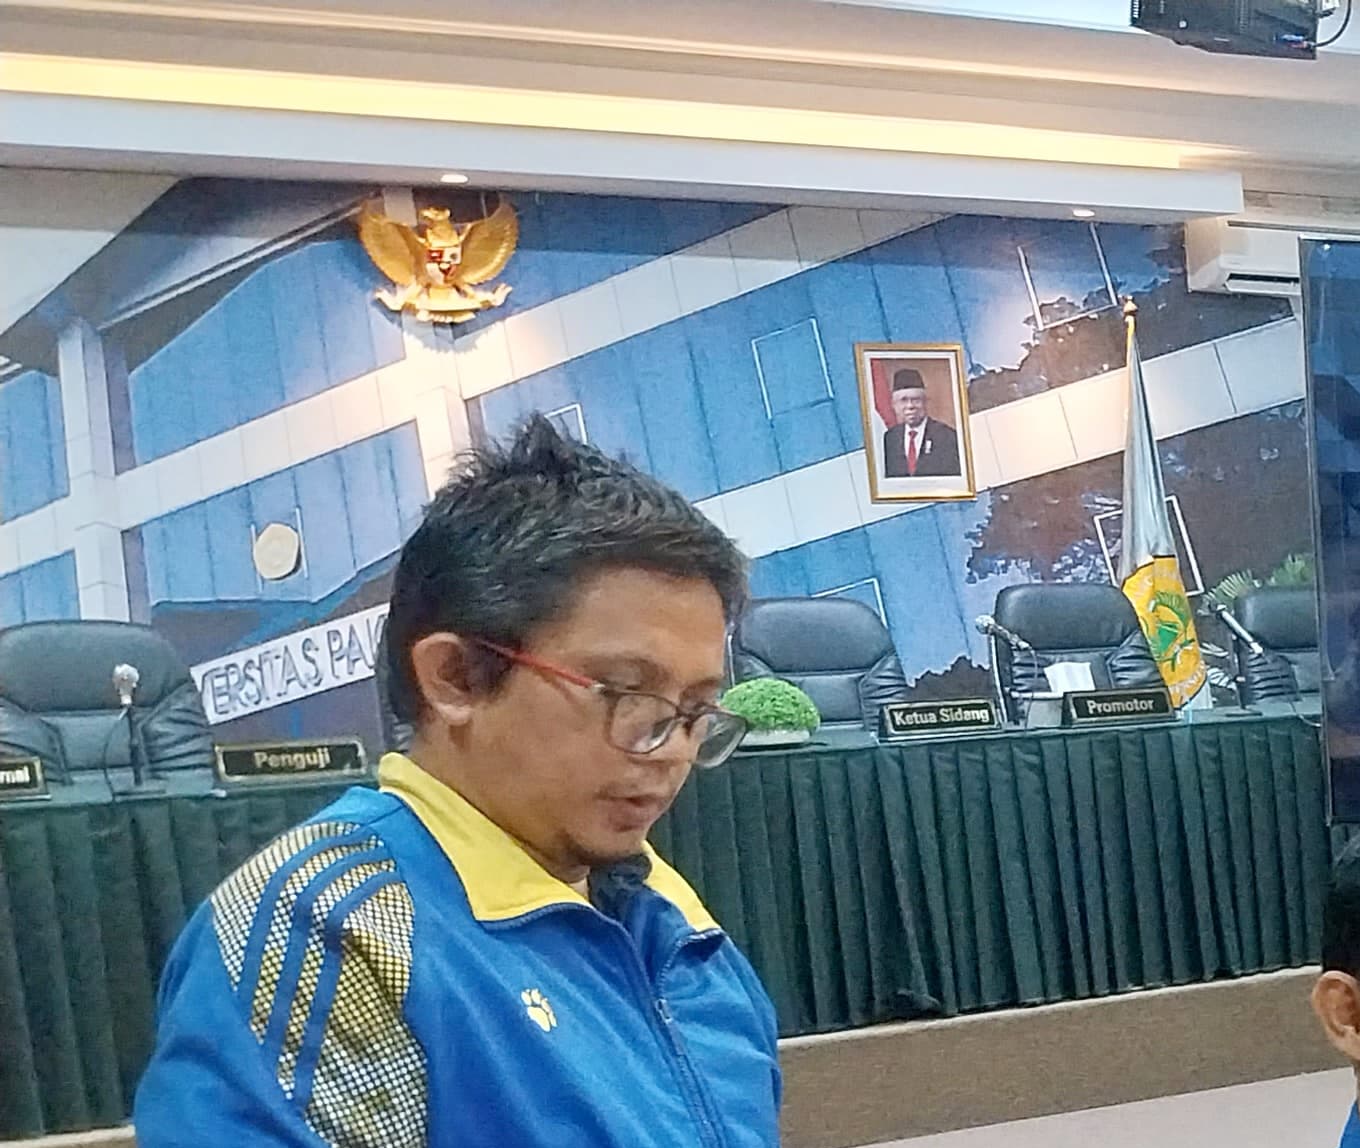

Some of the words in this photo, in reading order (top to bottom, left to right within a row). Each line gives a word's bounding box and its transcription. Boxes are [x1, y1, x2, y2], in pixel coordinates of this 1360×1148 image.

[893, 710, 938, 727] Ketua
[939, 706, 991, 725] Sidang
[1087, 698, 1155, 715] Promotor
[254, 747, 332, 769] Penguji
